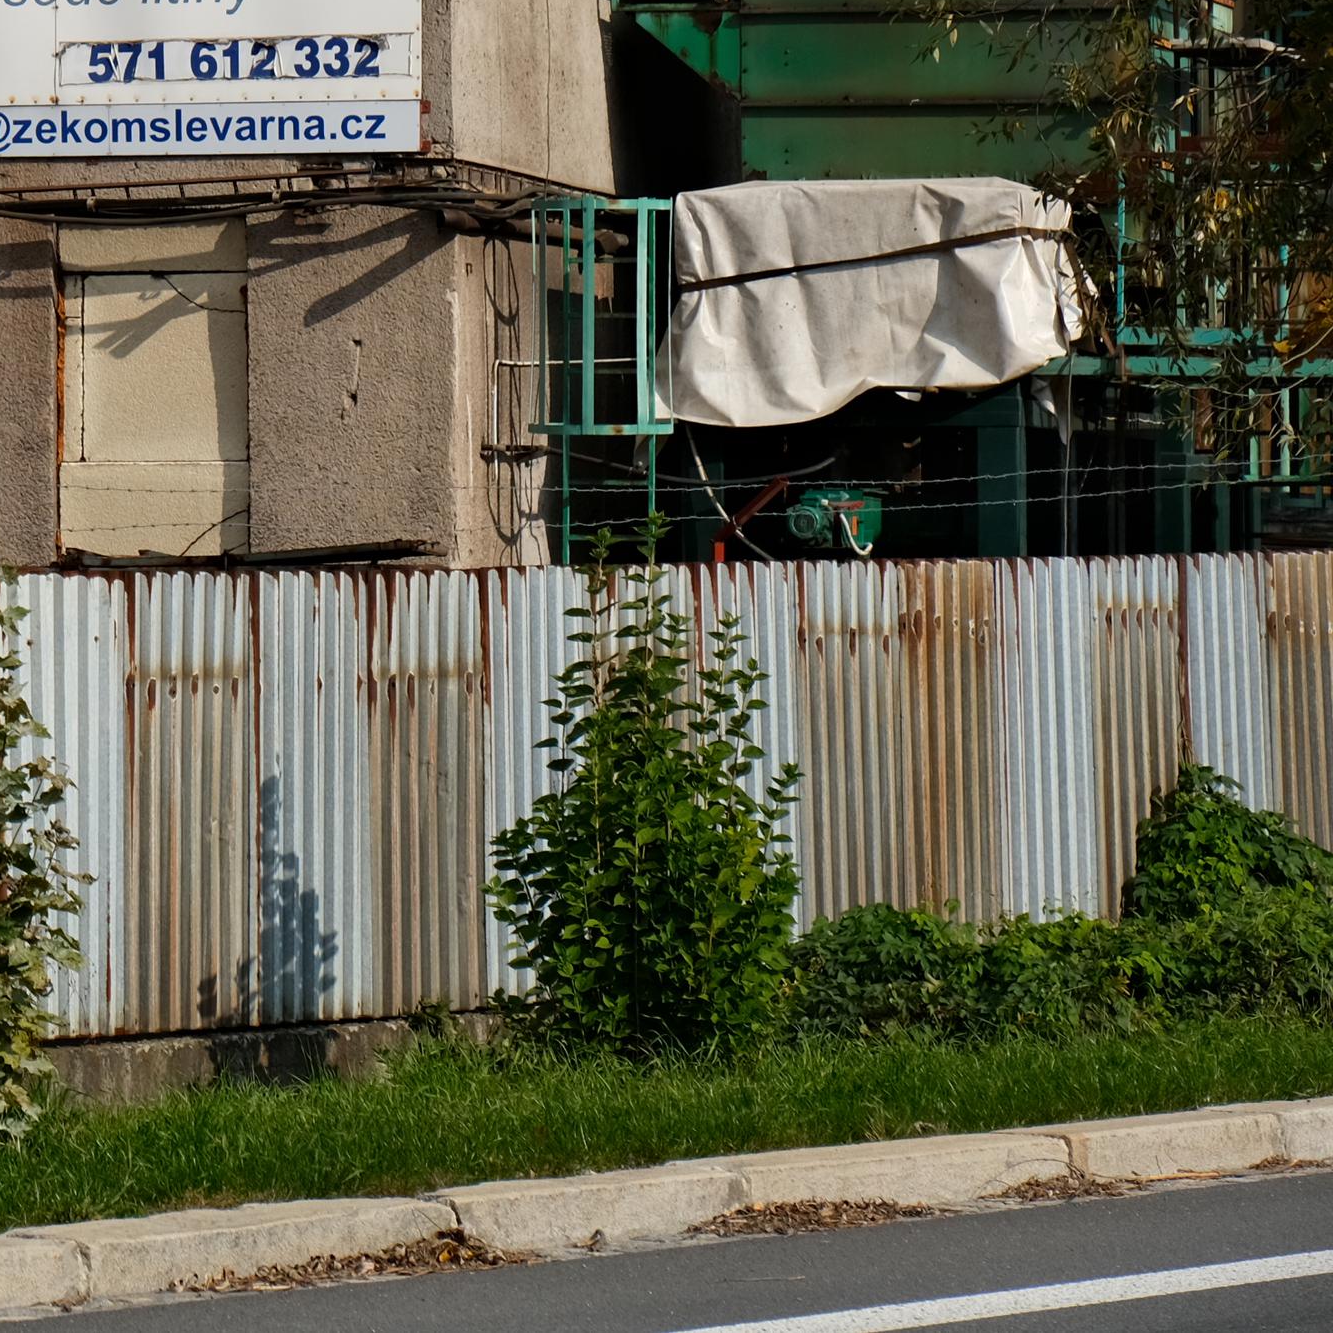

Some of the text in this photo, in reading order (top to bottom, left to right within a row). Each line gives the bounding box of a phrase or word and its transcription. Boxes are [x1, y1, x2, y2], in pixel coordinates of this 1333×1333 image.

[87, 42, 167, 83] 571
[190, 39, 276, 79] 612
[294, 37, 380, 78] 332
